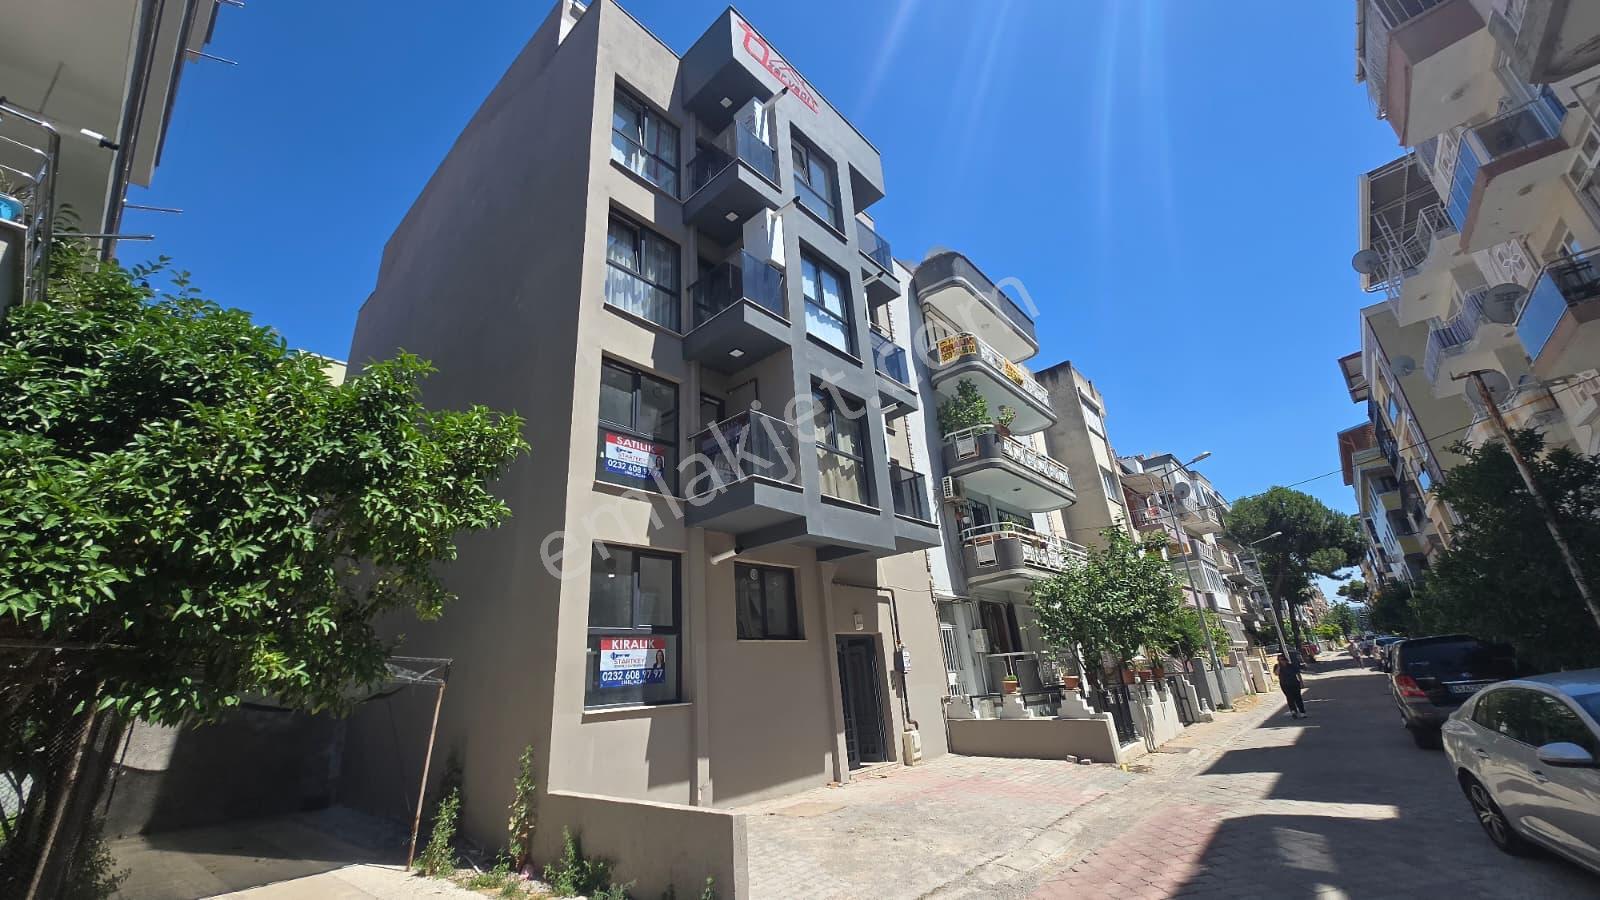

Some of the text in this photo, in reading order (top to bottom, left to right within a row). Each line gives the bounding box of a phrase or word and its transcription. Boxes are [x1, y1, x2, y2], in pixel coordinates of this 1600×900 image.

[616, 436, 655, 452] SATILIK
[607, 459, 626, 470] 0232
[602, 669, 663, 681] 0232 608 97 97
